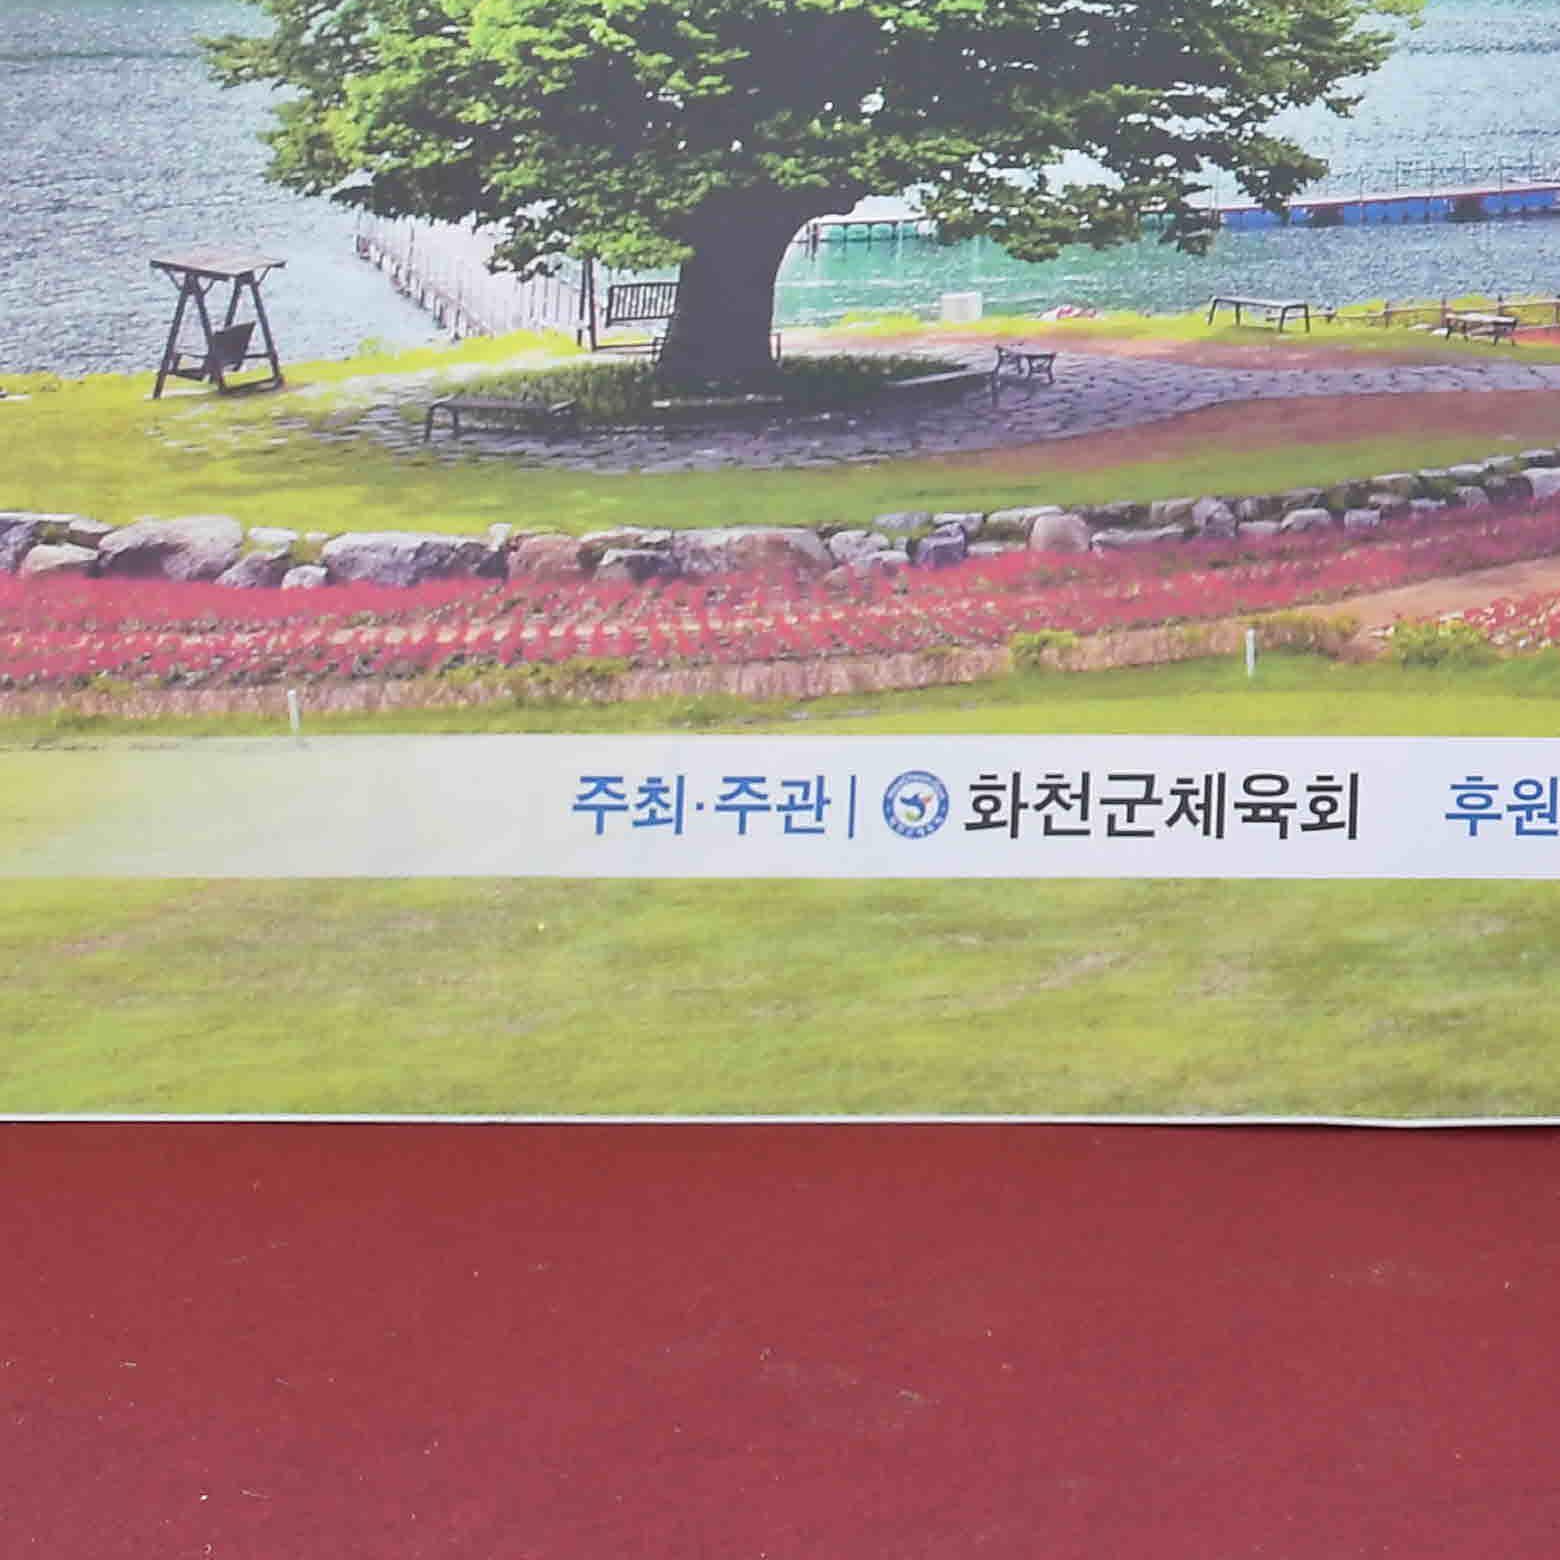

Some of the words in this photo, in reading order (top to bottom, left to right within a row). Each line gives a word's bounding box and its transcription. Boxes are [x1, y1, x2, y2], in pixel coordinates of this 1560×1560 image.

[571, 773, 831, 837] 주최·주관
[963, 769, 1361, 840] 화천군체육회
[1443, 774, 1560, 838] 후원
